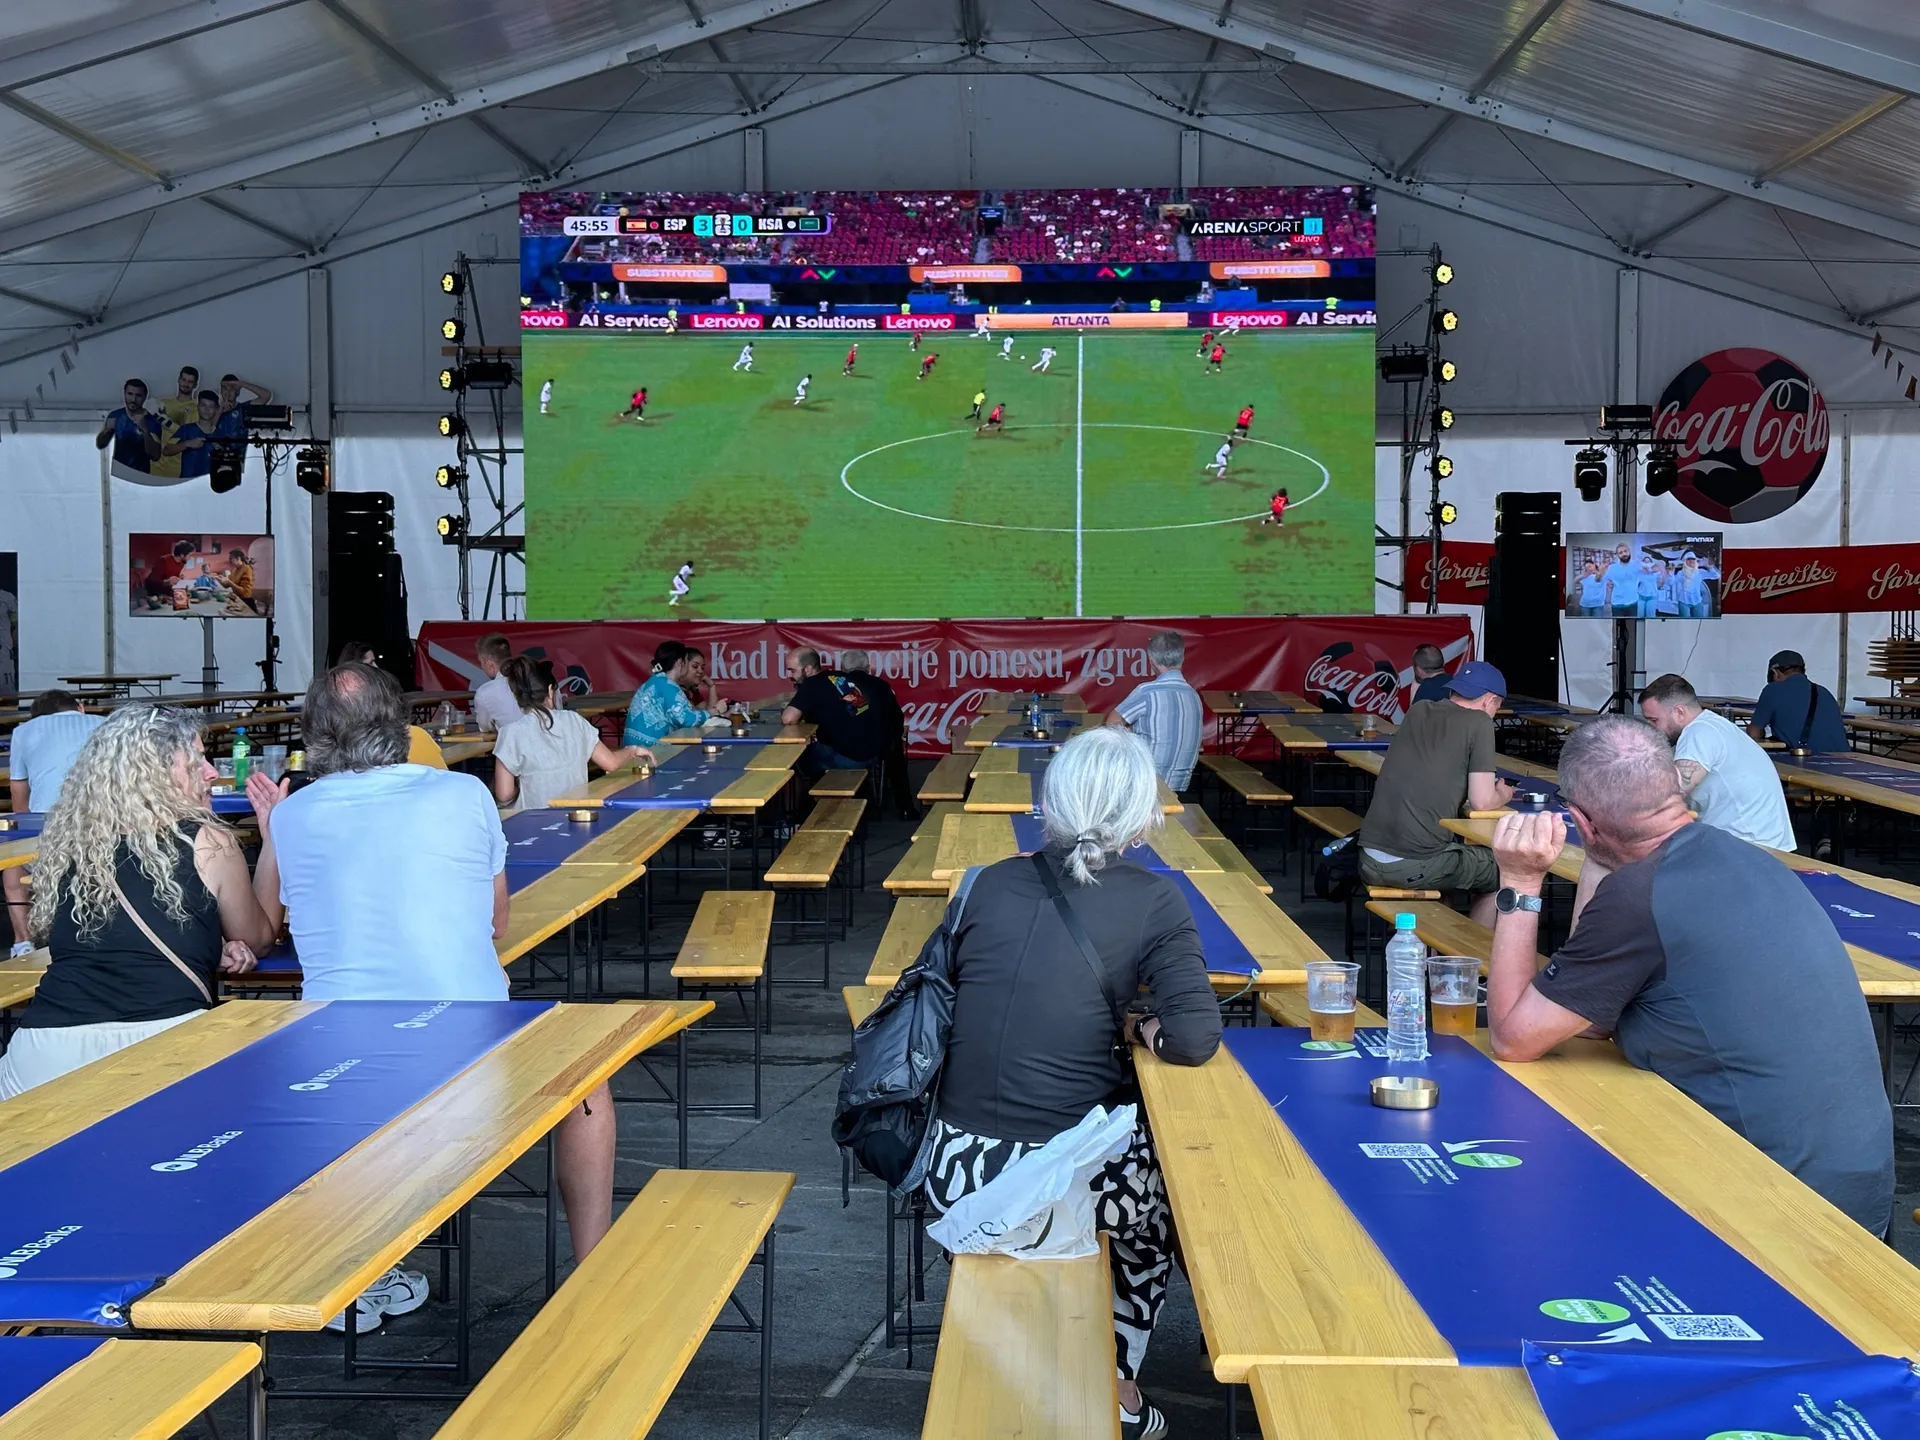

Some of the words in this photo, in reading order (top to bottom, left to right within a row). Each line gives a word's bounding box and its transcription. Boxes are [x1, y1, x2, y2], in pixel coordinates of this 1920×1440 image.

[570, 218, 608, 231] 45:55
[664, 218, 687, 230] ESP
[699, 219, 708, 231] 3
[738, 219, 748, 231] 0
[758, 218, 783, 230] KSA
[579, 314, 598, 327] AI
[604, 314, 670, 328] Service
[694, 315, 760, 329] Lenovo
[772, 316, 791, 328] AI
[796, 316, 876, 329] Solutions
[886, 315, 952, 329] Lenovo
[1051, 315, 1111, 326] ATLANTA
[1297, 312, 1318, 325] AI
[709, 640, 768, 681] Kad
[948, 648, 1071, 688] ponesu,
[1304, 654, 1400, 717] Coca-Cola
[174, 1148, 214, 1161] NLB
[196, 1130, 243, 1148] Banka
[22, 1225, 84, 1249] Banka
